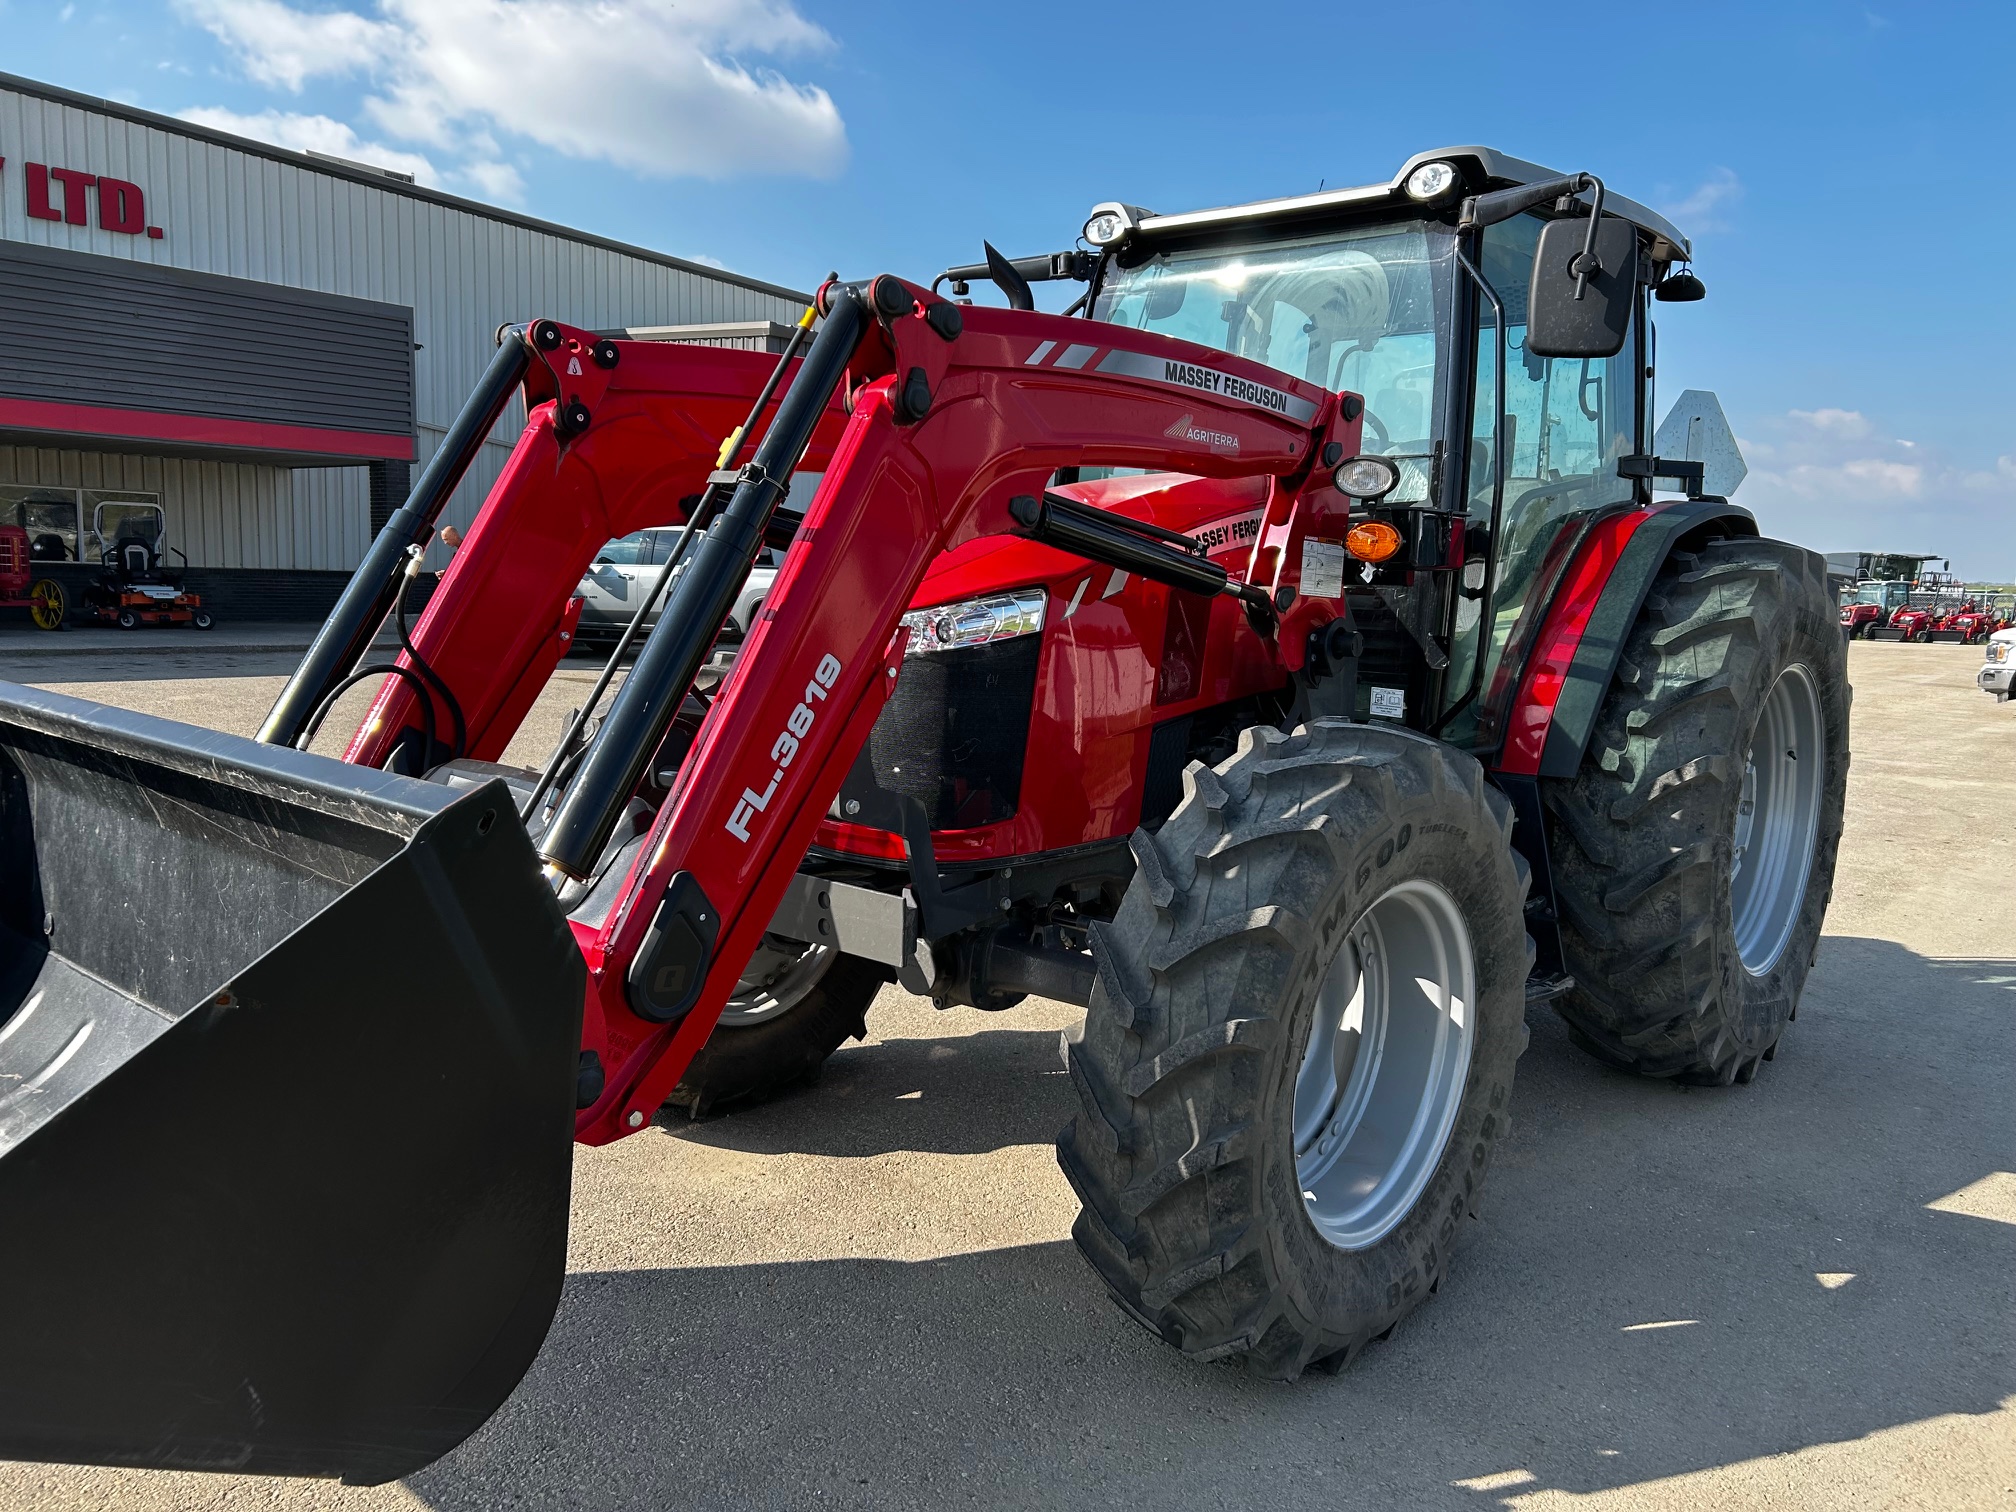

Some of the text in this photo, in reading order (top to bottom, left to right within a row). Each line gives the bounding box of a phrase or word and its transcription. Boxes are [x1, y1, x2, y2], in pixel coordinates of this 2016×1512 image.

[25, 162, 163, 239] LTD.
[1165, 361, 1287, 412] MASSEY FERGUSON
[1186, 428, 1239, 449] AGRITERRA
[724, 653, 842, 844] FL.3819
[1418, 824, 1470, 841] TUBELESS
